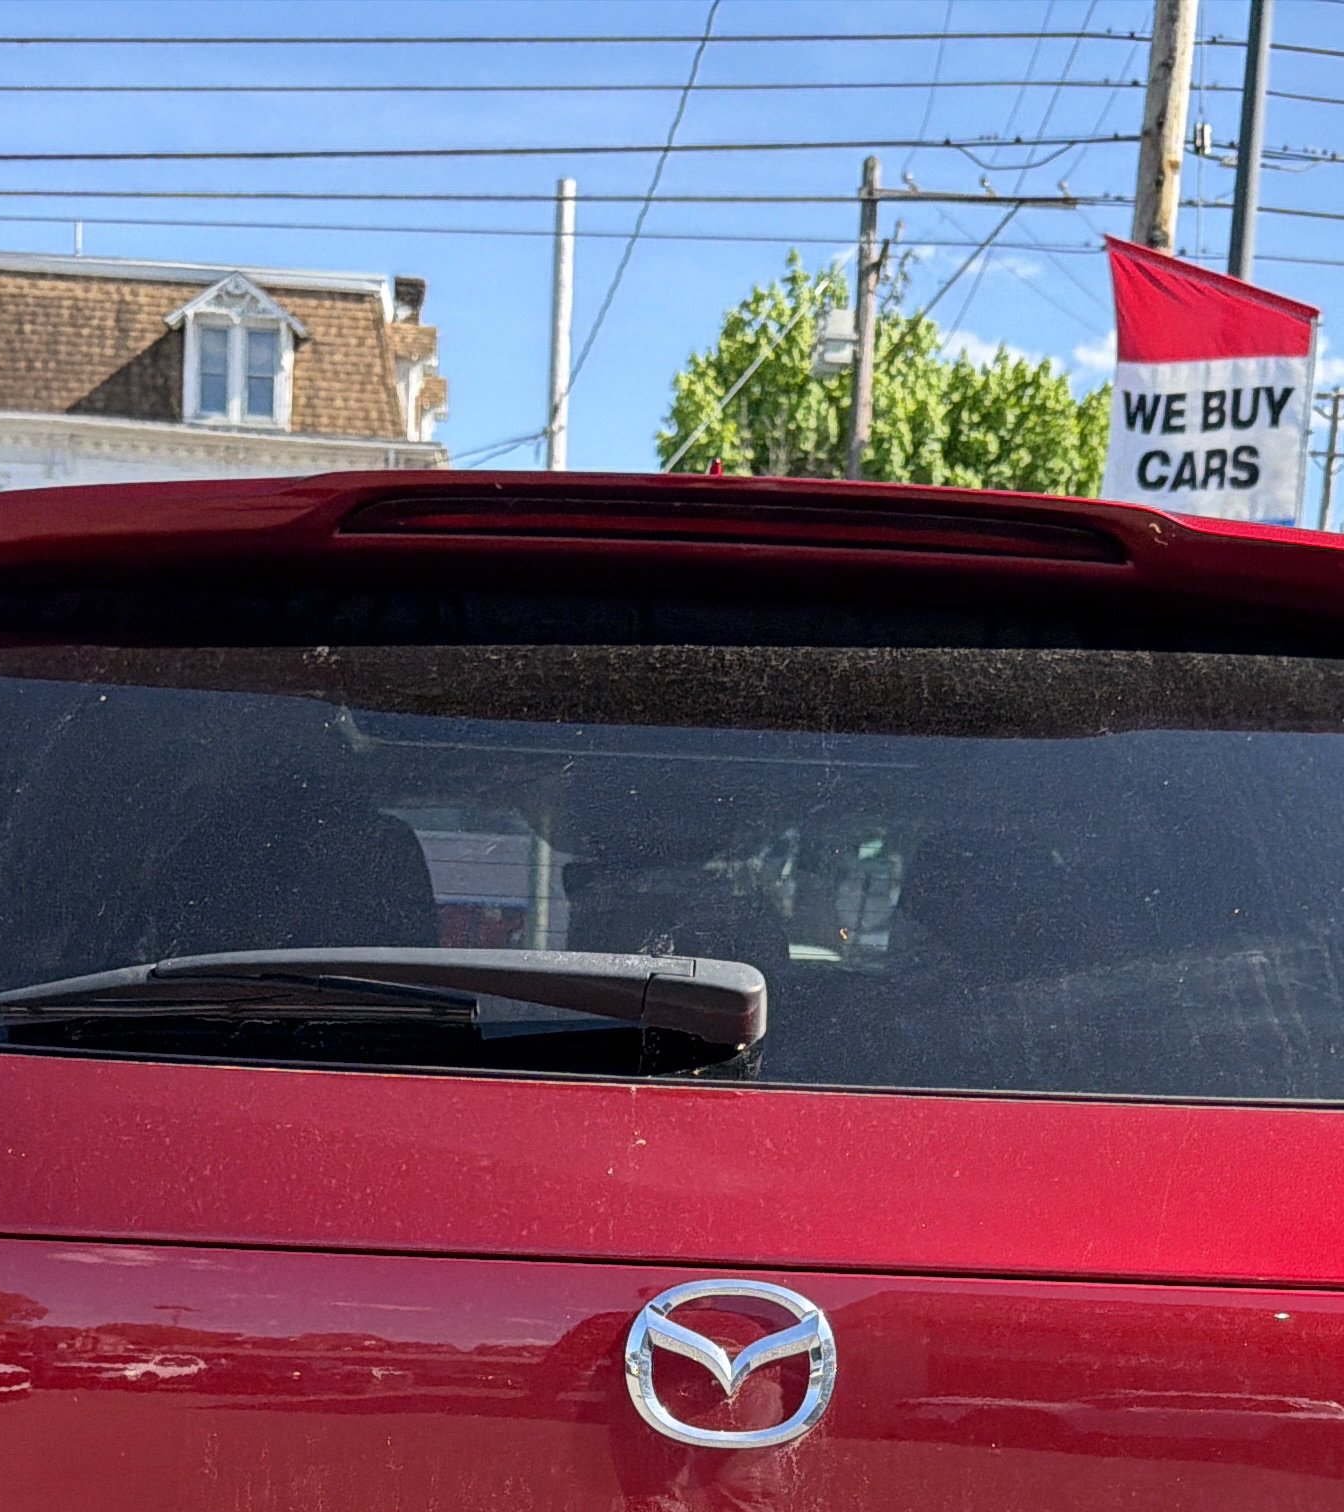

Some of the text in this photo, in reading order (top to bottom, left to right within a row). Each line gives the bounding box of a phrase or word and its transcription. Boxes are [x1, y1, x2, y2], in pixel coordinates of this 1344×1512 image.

[1123, 386, 1294, 434] WE BUY
[1137, 445, 1261, 491] CARS
